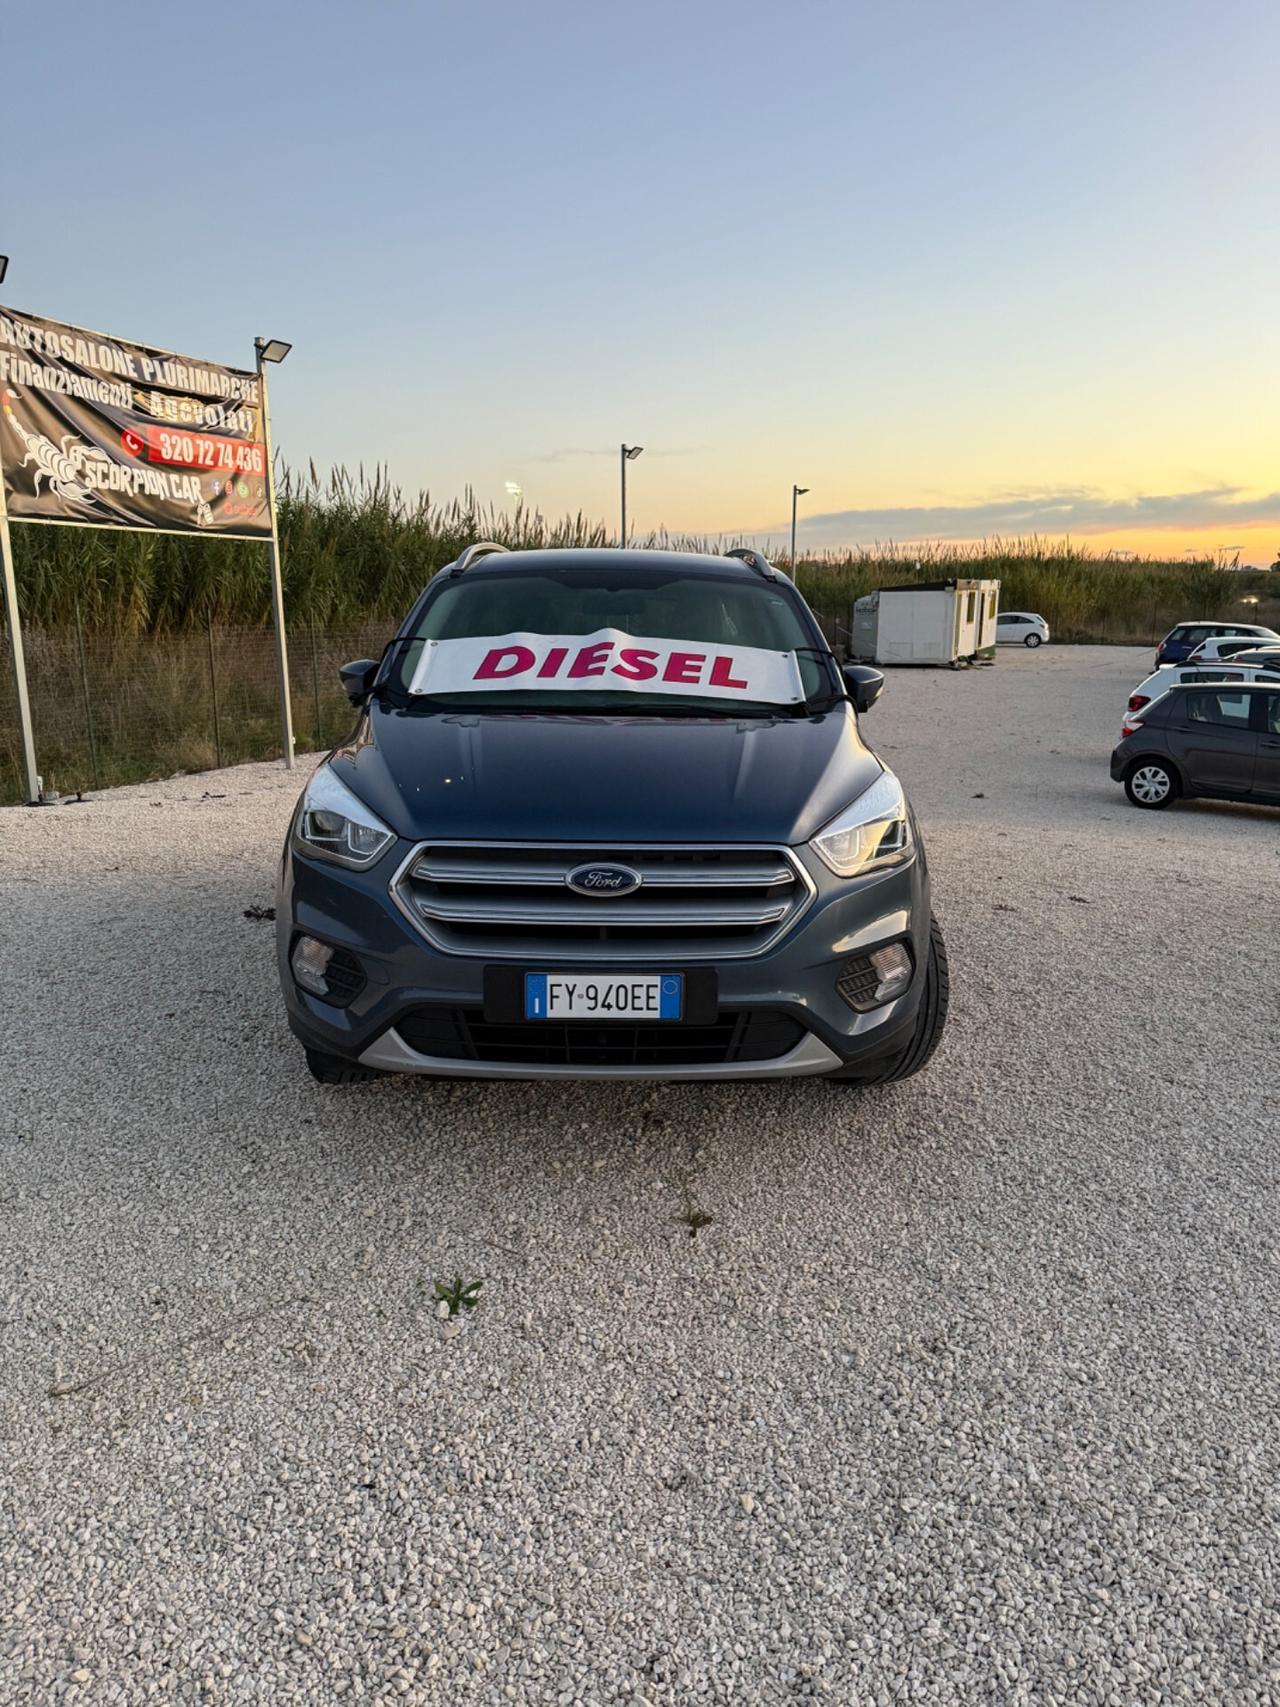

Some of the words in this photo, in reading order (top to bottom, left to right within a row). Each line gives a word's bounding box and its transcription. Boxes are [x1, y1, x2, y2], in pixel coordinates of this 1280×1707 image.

[0, 315, 138, 378] AUTOSALONE
[141, 357, 259, 404] PLURIMARCHE
[0, 350, 133, 410] Finanziamenti
[160, 433, 194, 463] 320
[196, 440, 215, 466] 72
[217, 442, 234, 469] 74
[236, 445, 263, 473] 436
[84, 460, 167, 501] SCORPION
[169, 474, 202, 503] CAR
[473, 642, 748, 689] DIESEL
[584, 871, 622, 888] Ford
